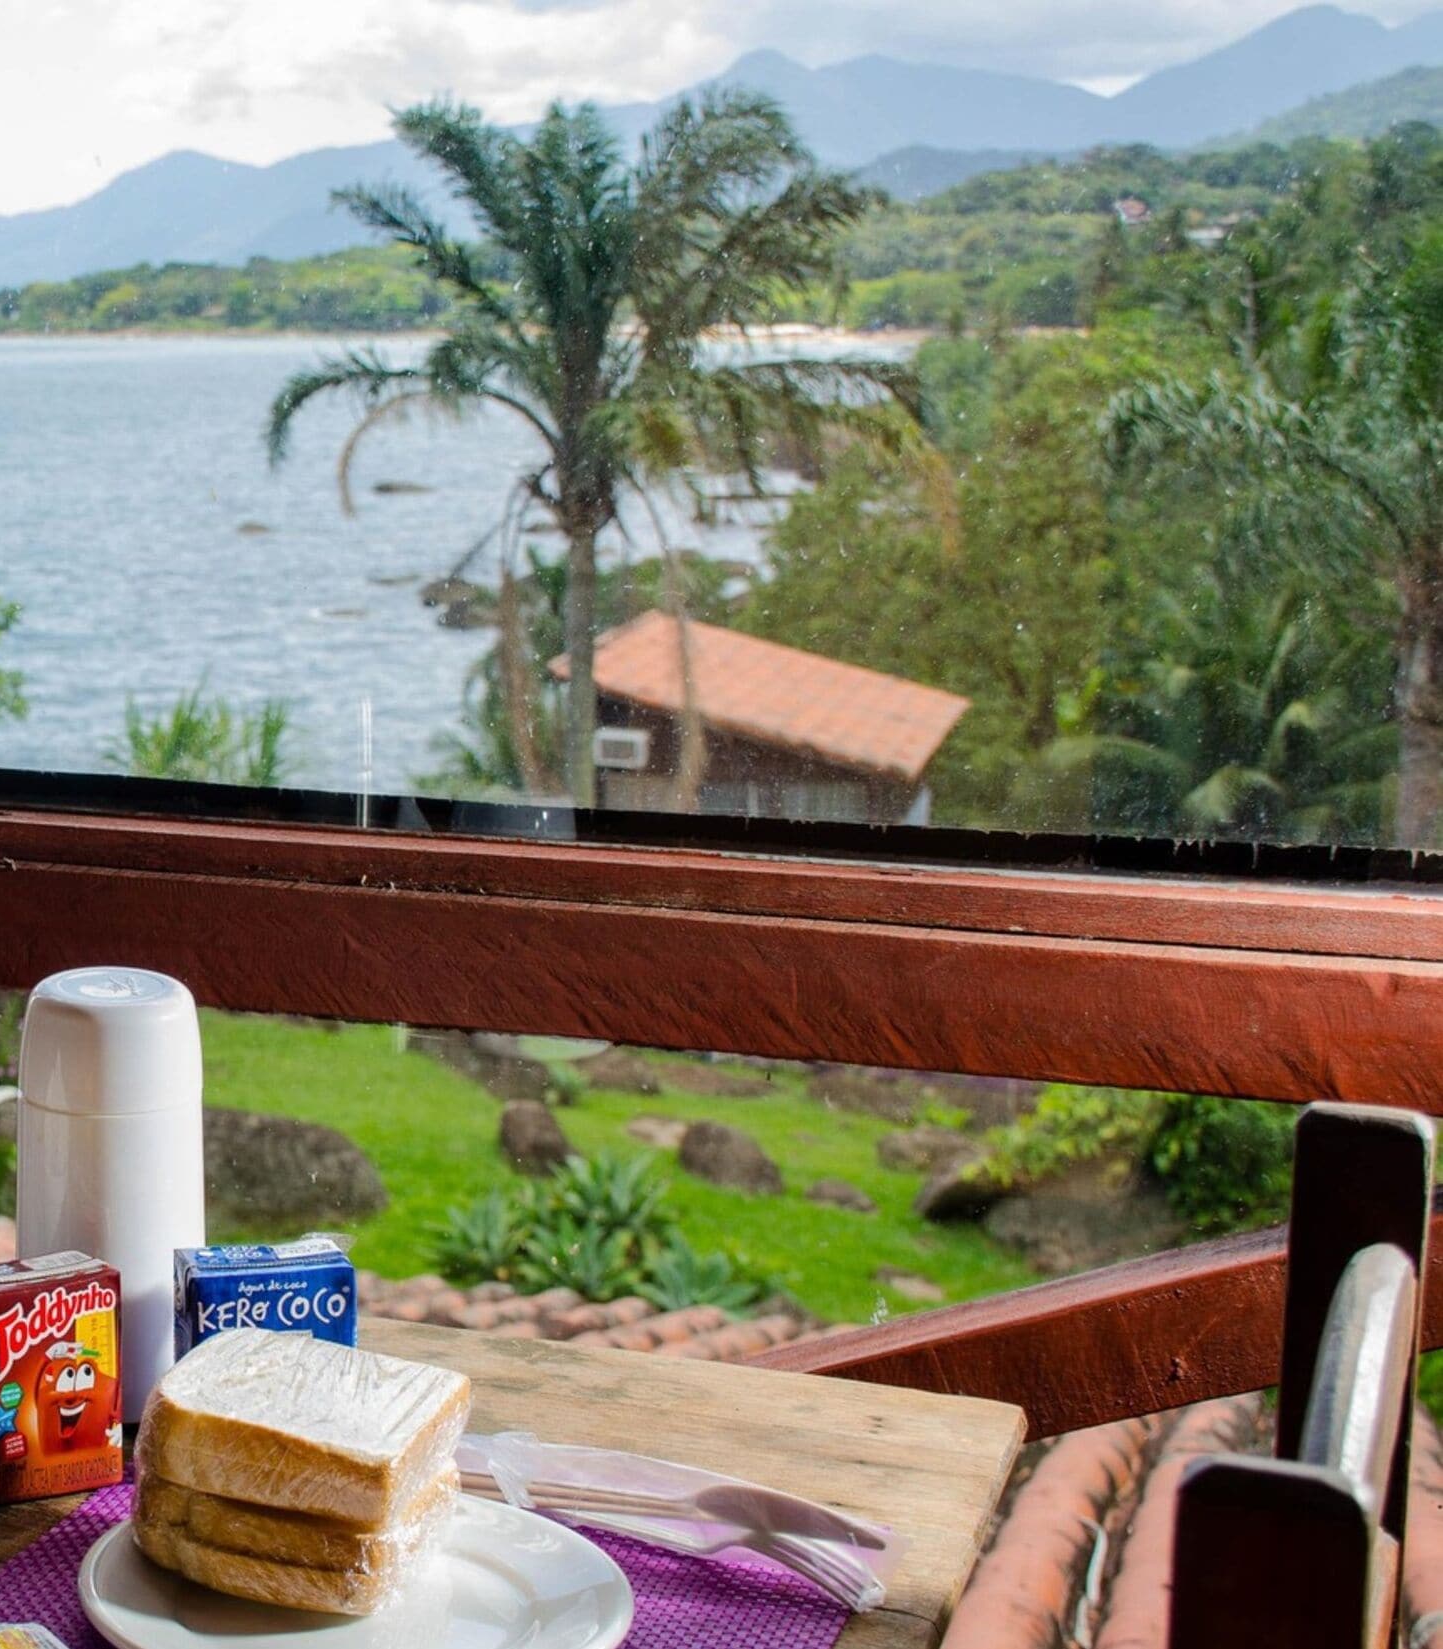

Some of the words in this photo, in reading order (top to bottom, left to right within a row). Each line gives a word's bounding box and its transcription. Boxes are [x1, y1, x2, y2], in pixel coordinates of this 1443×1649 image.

[283, 1281, 307, 1290] coco
[197, 1297, 270, 1334] KERO
[276, 1287, 346, 1326] COCO
